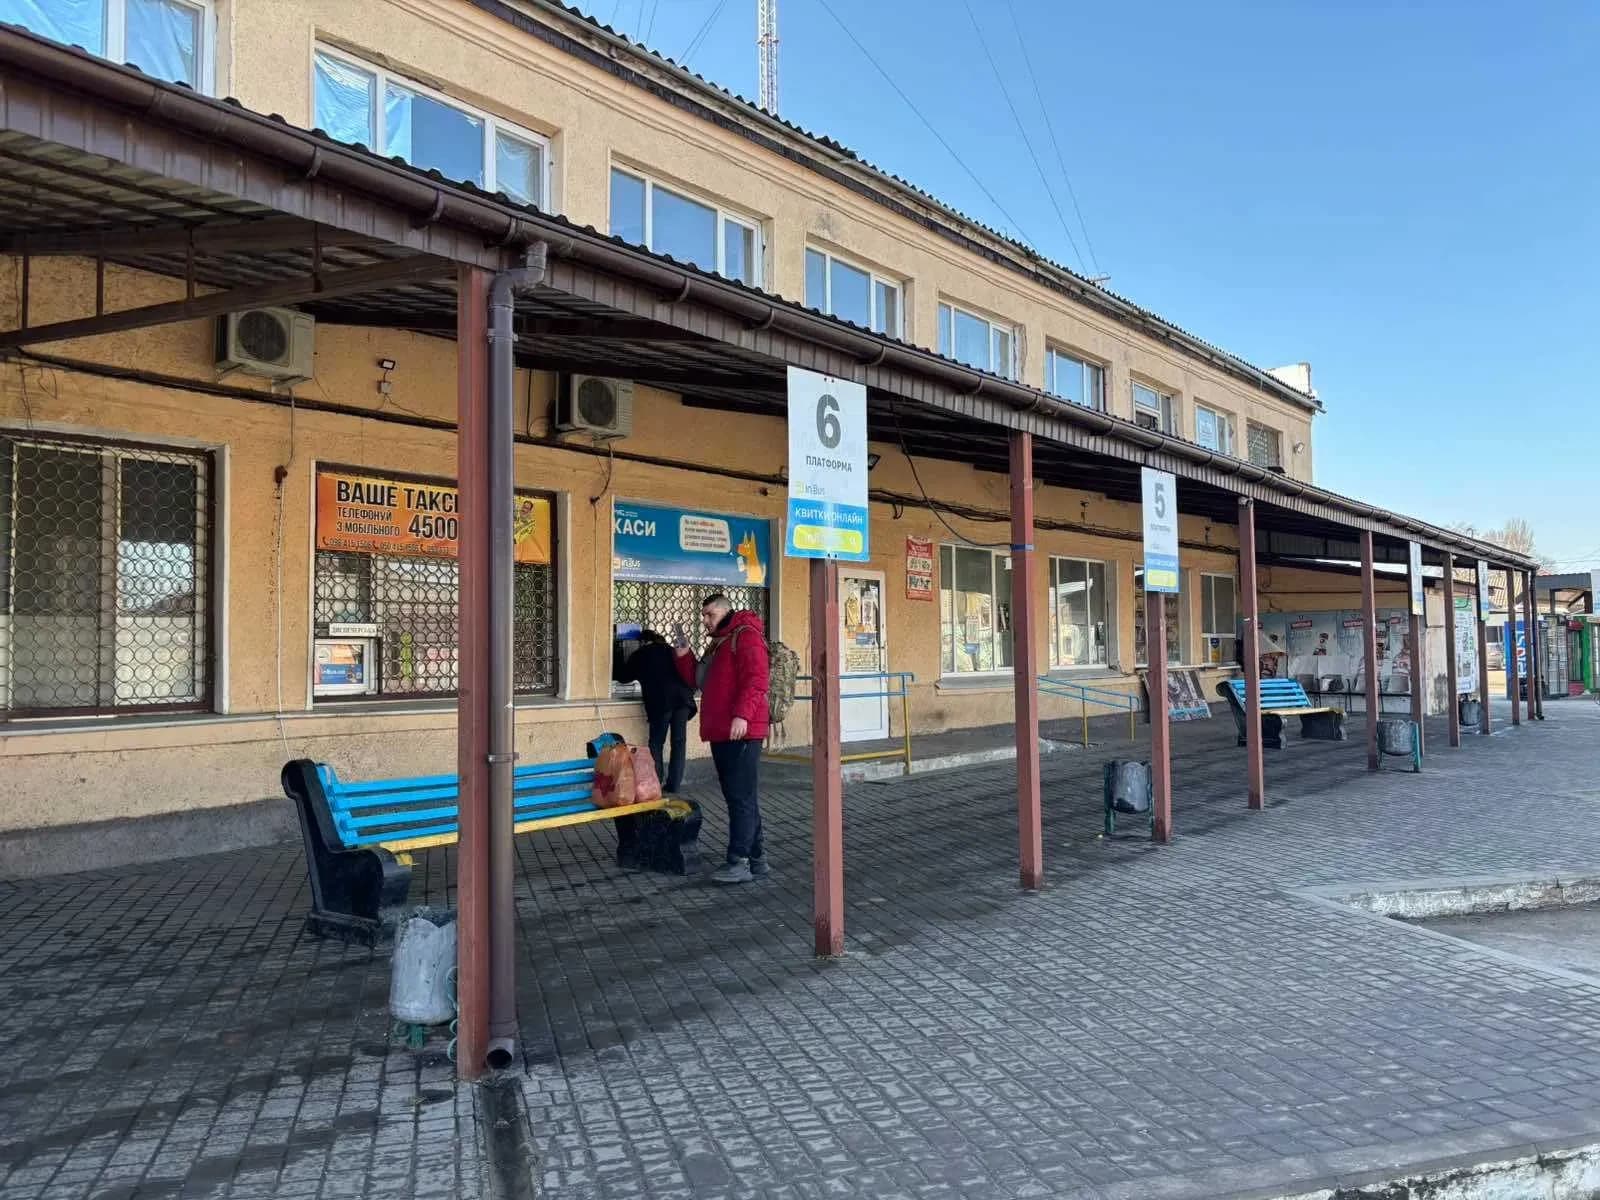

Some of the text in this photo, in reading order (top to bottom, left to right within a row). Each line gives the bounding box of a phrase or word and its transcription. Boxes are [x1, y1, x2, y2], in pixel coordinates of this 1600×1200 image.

[815, 394, 841, 449] 6
[806, 456, 852, 473] ПЛАТФОРМА
[337, 480, 397, 507] ВАШЕ
[1154, 483, 1165, 519] 5
[337, 506, 392, 521] ТЕЛЕФОНУЙ
[795, 506, 863, 525] КВИТКИ ОНЛАЙН
[345, 523, 400, 536] МОБІЛЬНОГО
[408, 514, 458, 540] 4500
